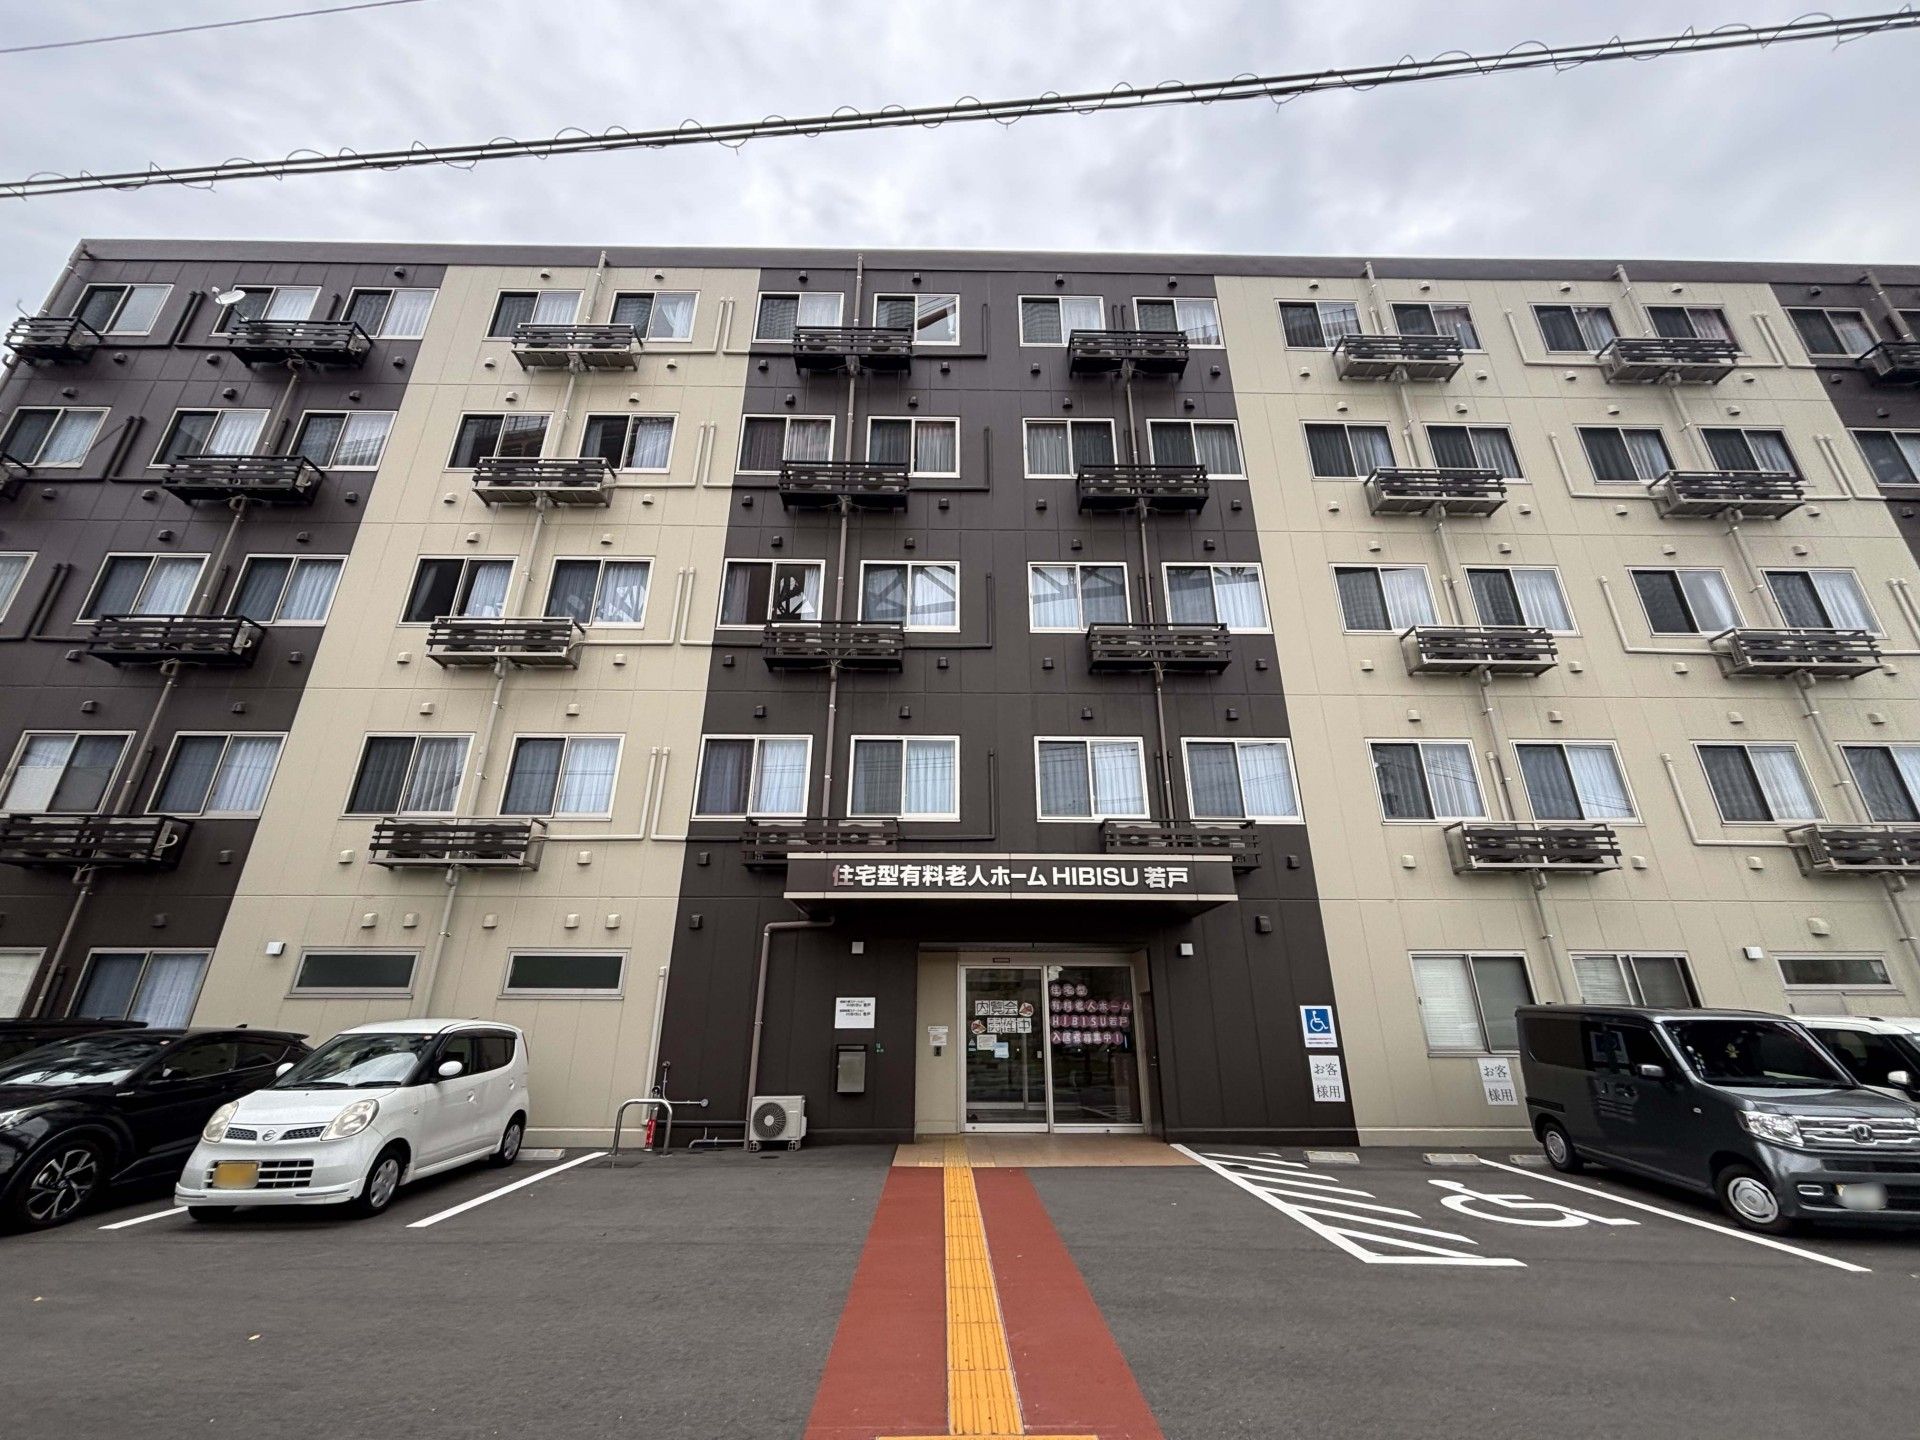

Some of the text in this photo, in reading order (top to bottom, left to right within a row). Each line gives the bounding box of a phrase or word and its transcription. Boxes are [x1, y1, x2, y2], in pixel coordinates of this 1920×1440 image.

[832, 864, 1189, 889] 住宅型有料老人ホーム HIBISU 若戸
[1314, 1062, 1338, 1076] お客
[1484, 1065, 1507, 1078] お客
[1316, 1085, 1341, 1099] 様用
[1488, 1088, 1514, 1101] 様用
